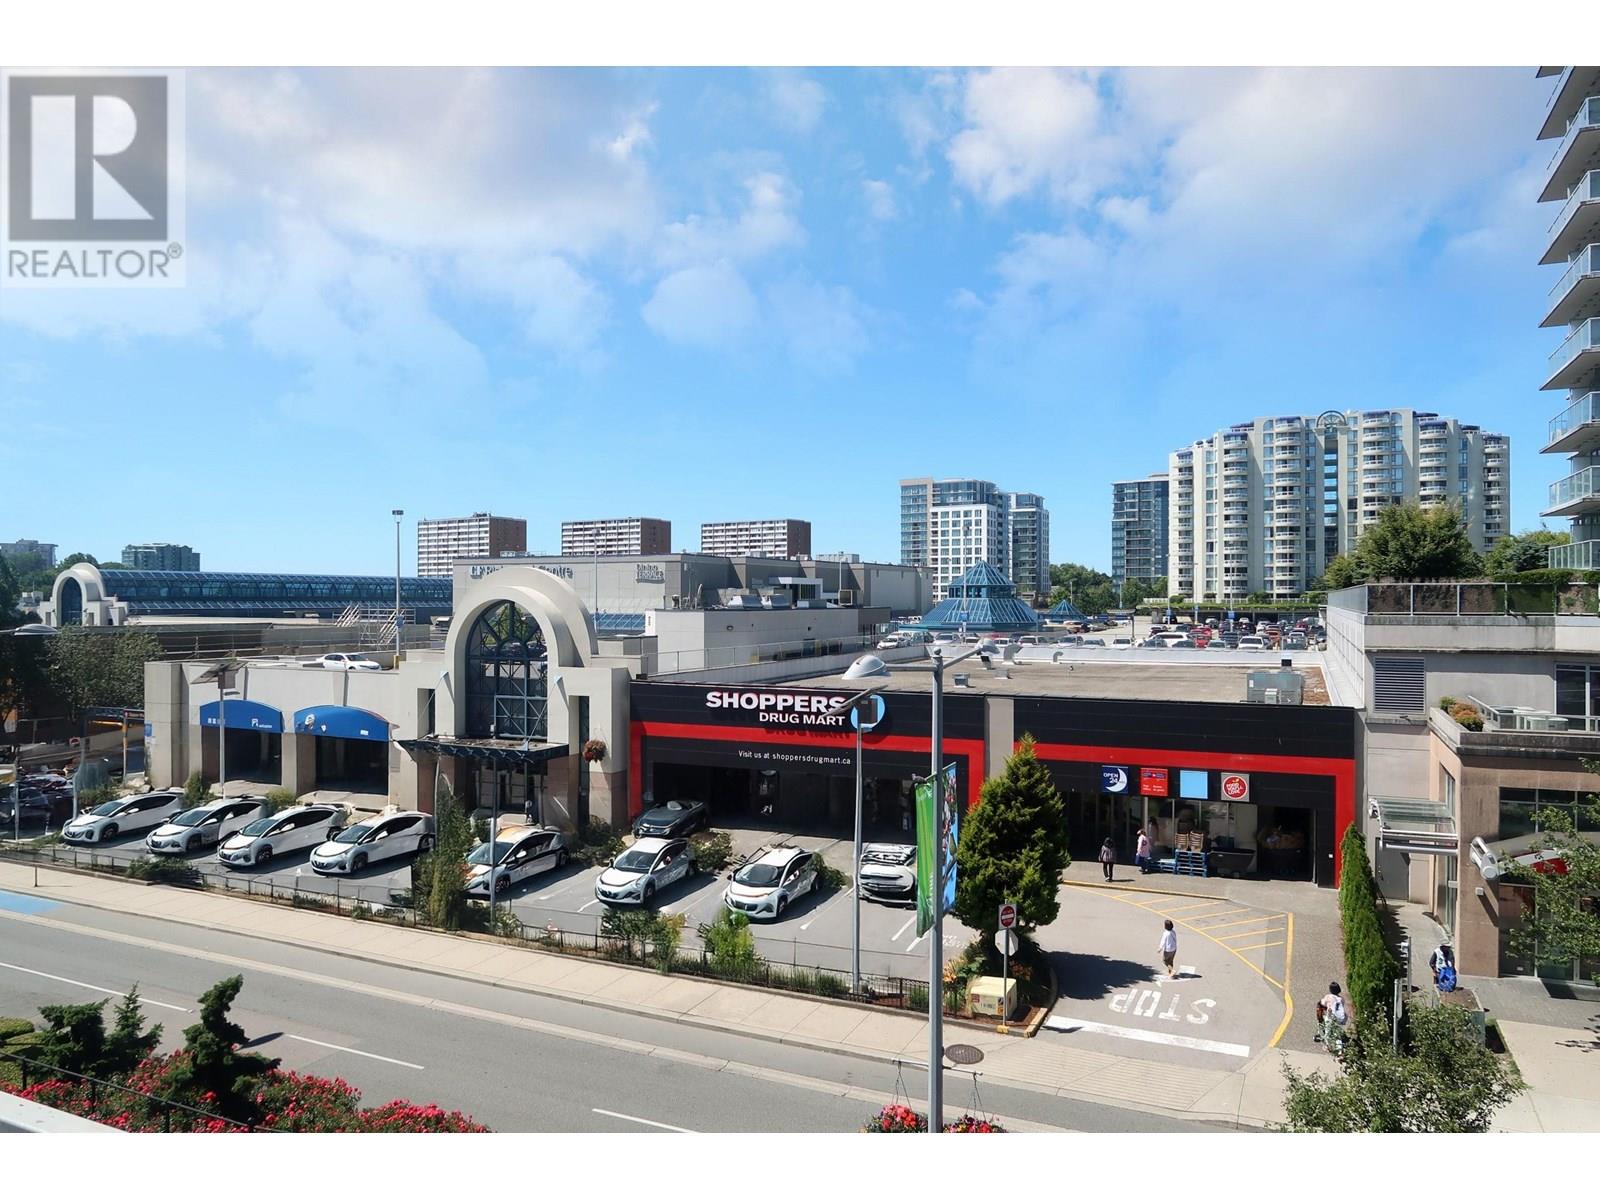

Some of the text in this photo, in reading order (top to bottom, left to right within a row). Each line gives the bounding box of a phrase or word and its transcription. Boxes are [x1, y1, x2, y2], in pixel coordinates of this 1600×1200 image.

[705, 691, 847, 713] SHOPPERS
[759, 712, 846, 726] DRUG MART
[738, 750, 752, 758] Visit
[772, 753, 851, 765] shoppersdrugmart.ca
[1108, 988, 1217, 1025] STOP
